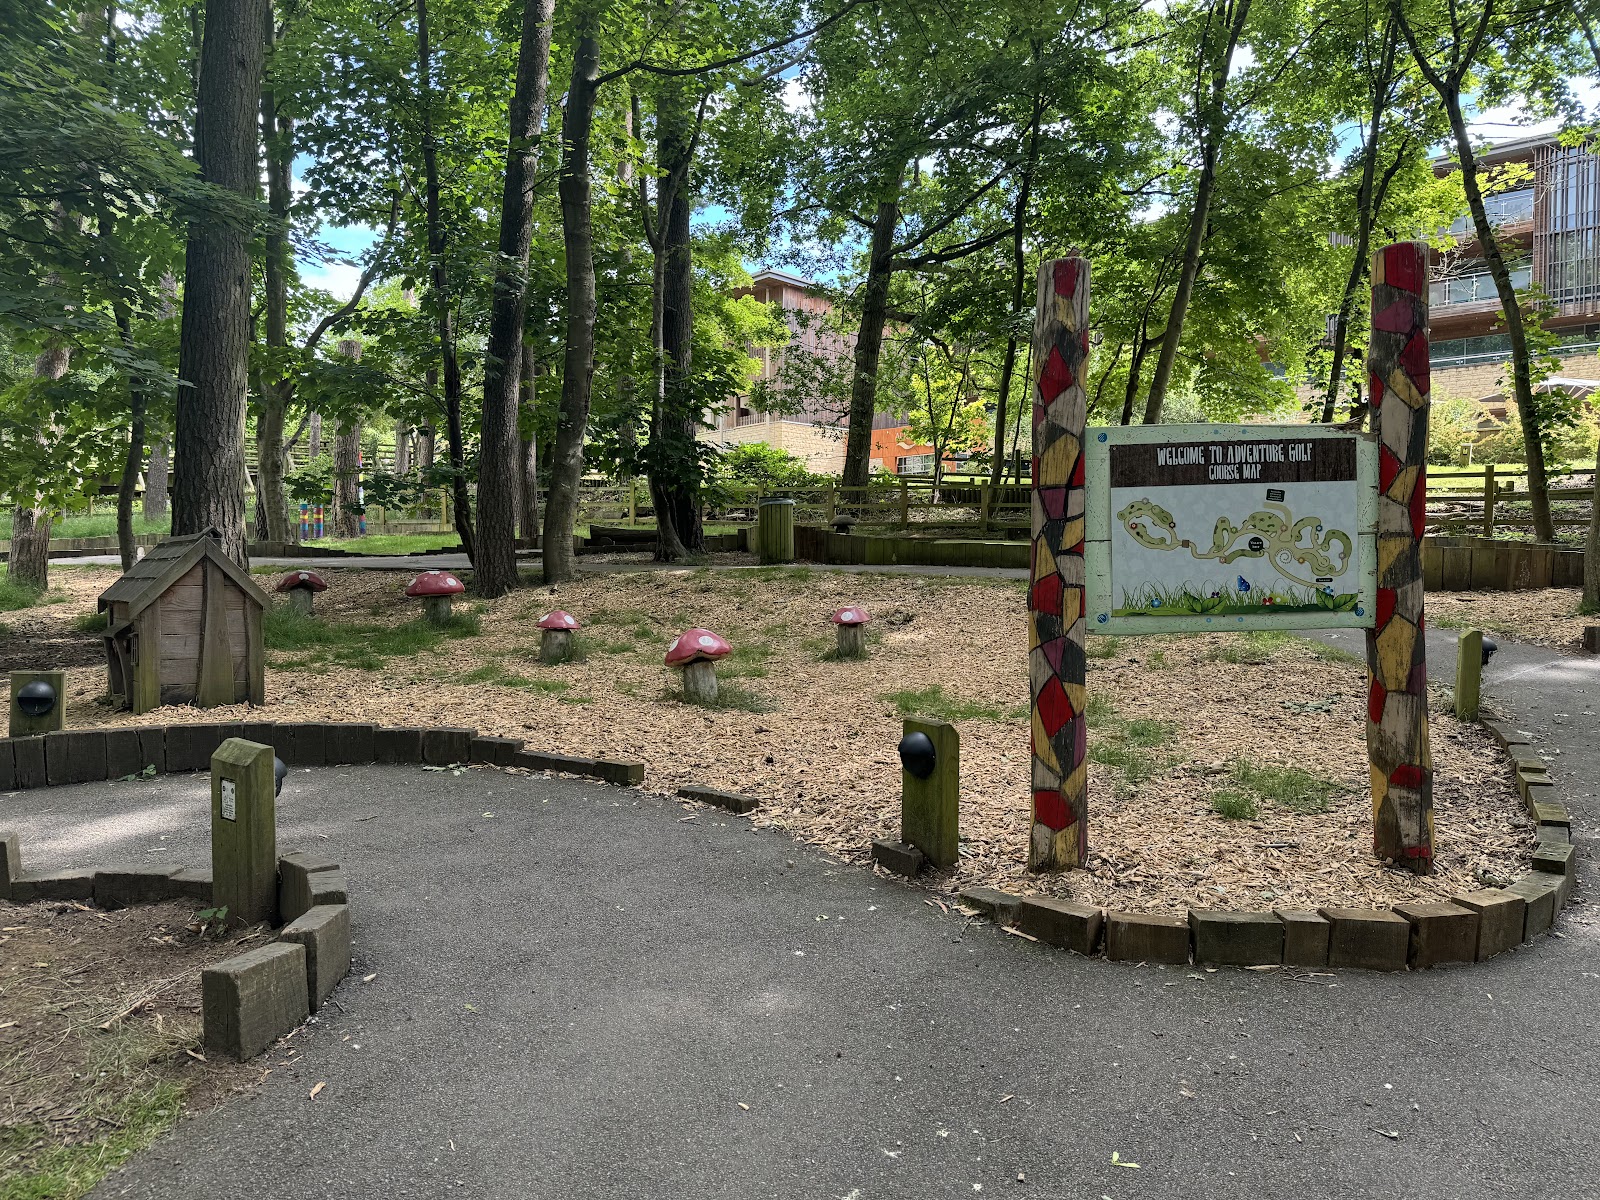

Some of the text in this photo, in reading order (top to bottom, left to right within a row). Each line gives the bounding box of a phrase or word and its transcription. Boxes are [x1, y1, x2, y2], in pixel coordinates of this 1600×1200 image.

[1157, 443, 1312, 466] WELCOME TO ADVENTURE GOLF
[1209, 464, 1261, 480] COURSE MAP
